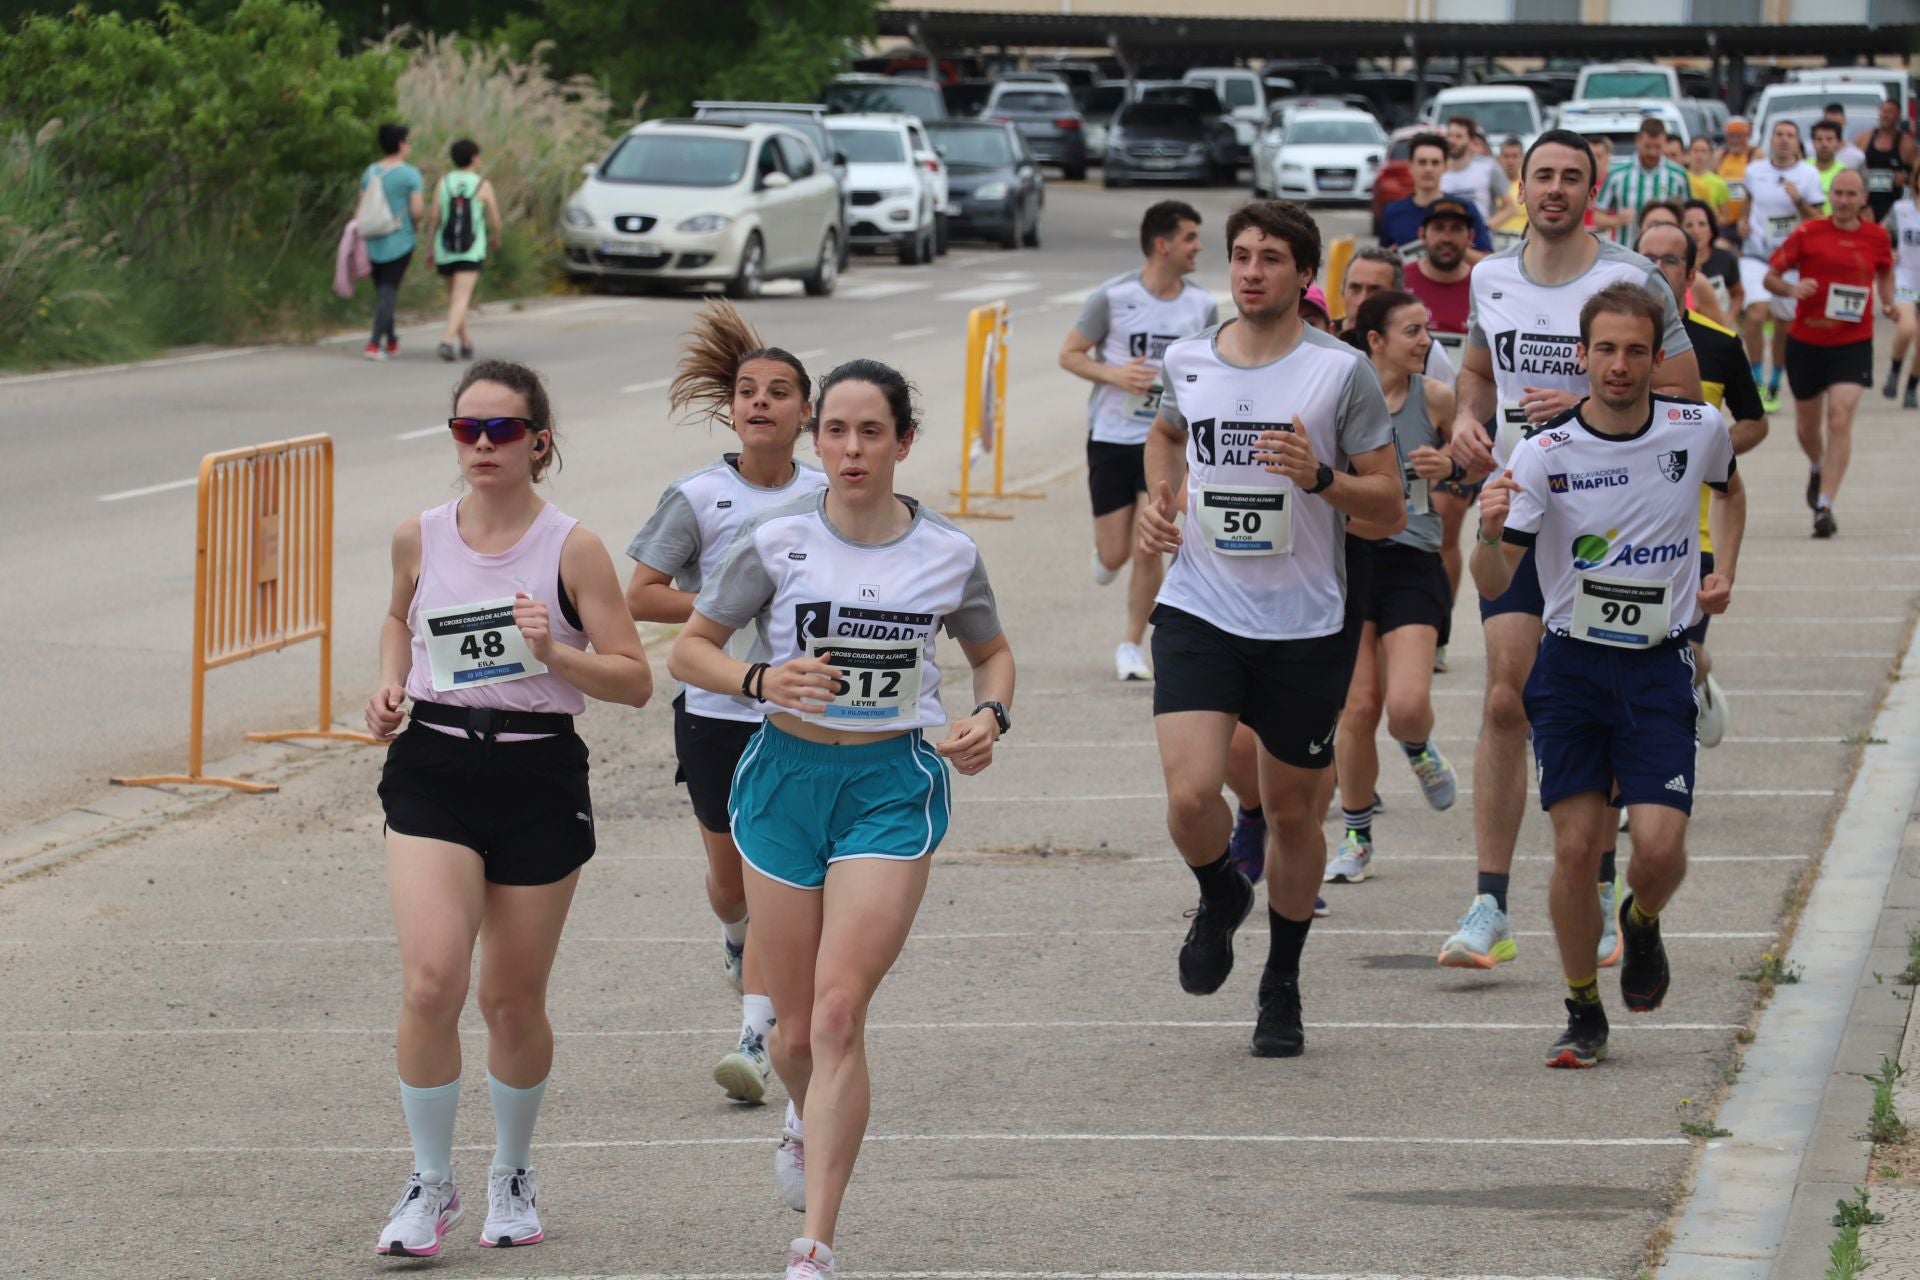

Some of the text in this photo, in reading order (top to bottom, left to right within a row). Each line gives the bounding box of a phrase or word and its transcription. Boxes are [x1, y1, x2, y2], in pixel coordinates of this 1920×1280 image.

[1520, 343, 1573, 359] CIUDAD
[1682, 409, 1702, 420] BS
[1221, 433, 1259, 447] CIUD
[1550, 431, 1570, 442] BS
[1570, 467, 1629, 480] EXCAVACIONES
[1571, 474, 1629, 491] MAPILO
[1223, 511, 1262, 534] 50
[1609, 538, 1689, 567] Aema
[862, 588, 877, 598] IN
[443, 619, 463, 627] CROSS
[462, 614, 486, 624] CIUDAD
[484, 612, 494, 620] DE
[1601, 601, 1642, 626] 90
[836, 621, 915, 641] CIUDAD
[460, 630, 506, 660] 48
[477, 659, 496, 668] EILA
[851, 652, 876, 660] CIUDAD
[831, 669, 902, 698] 512
